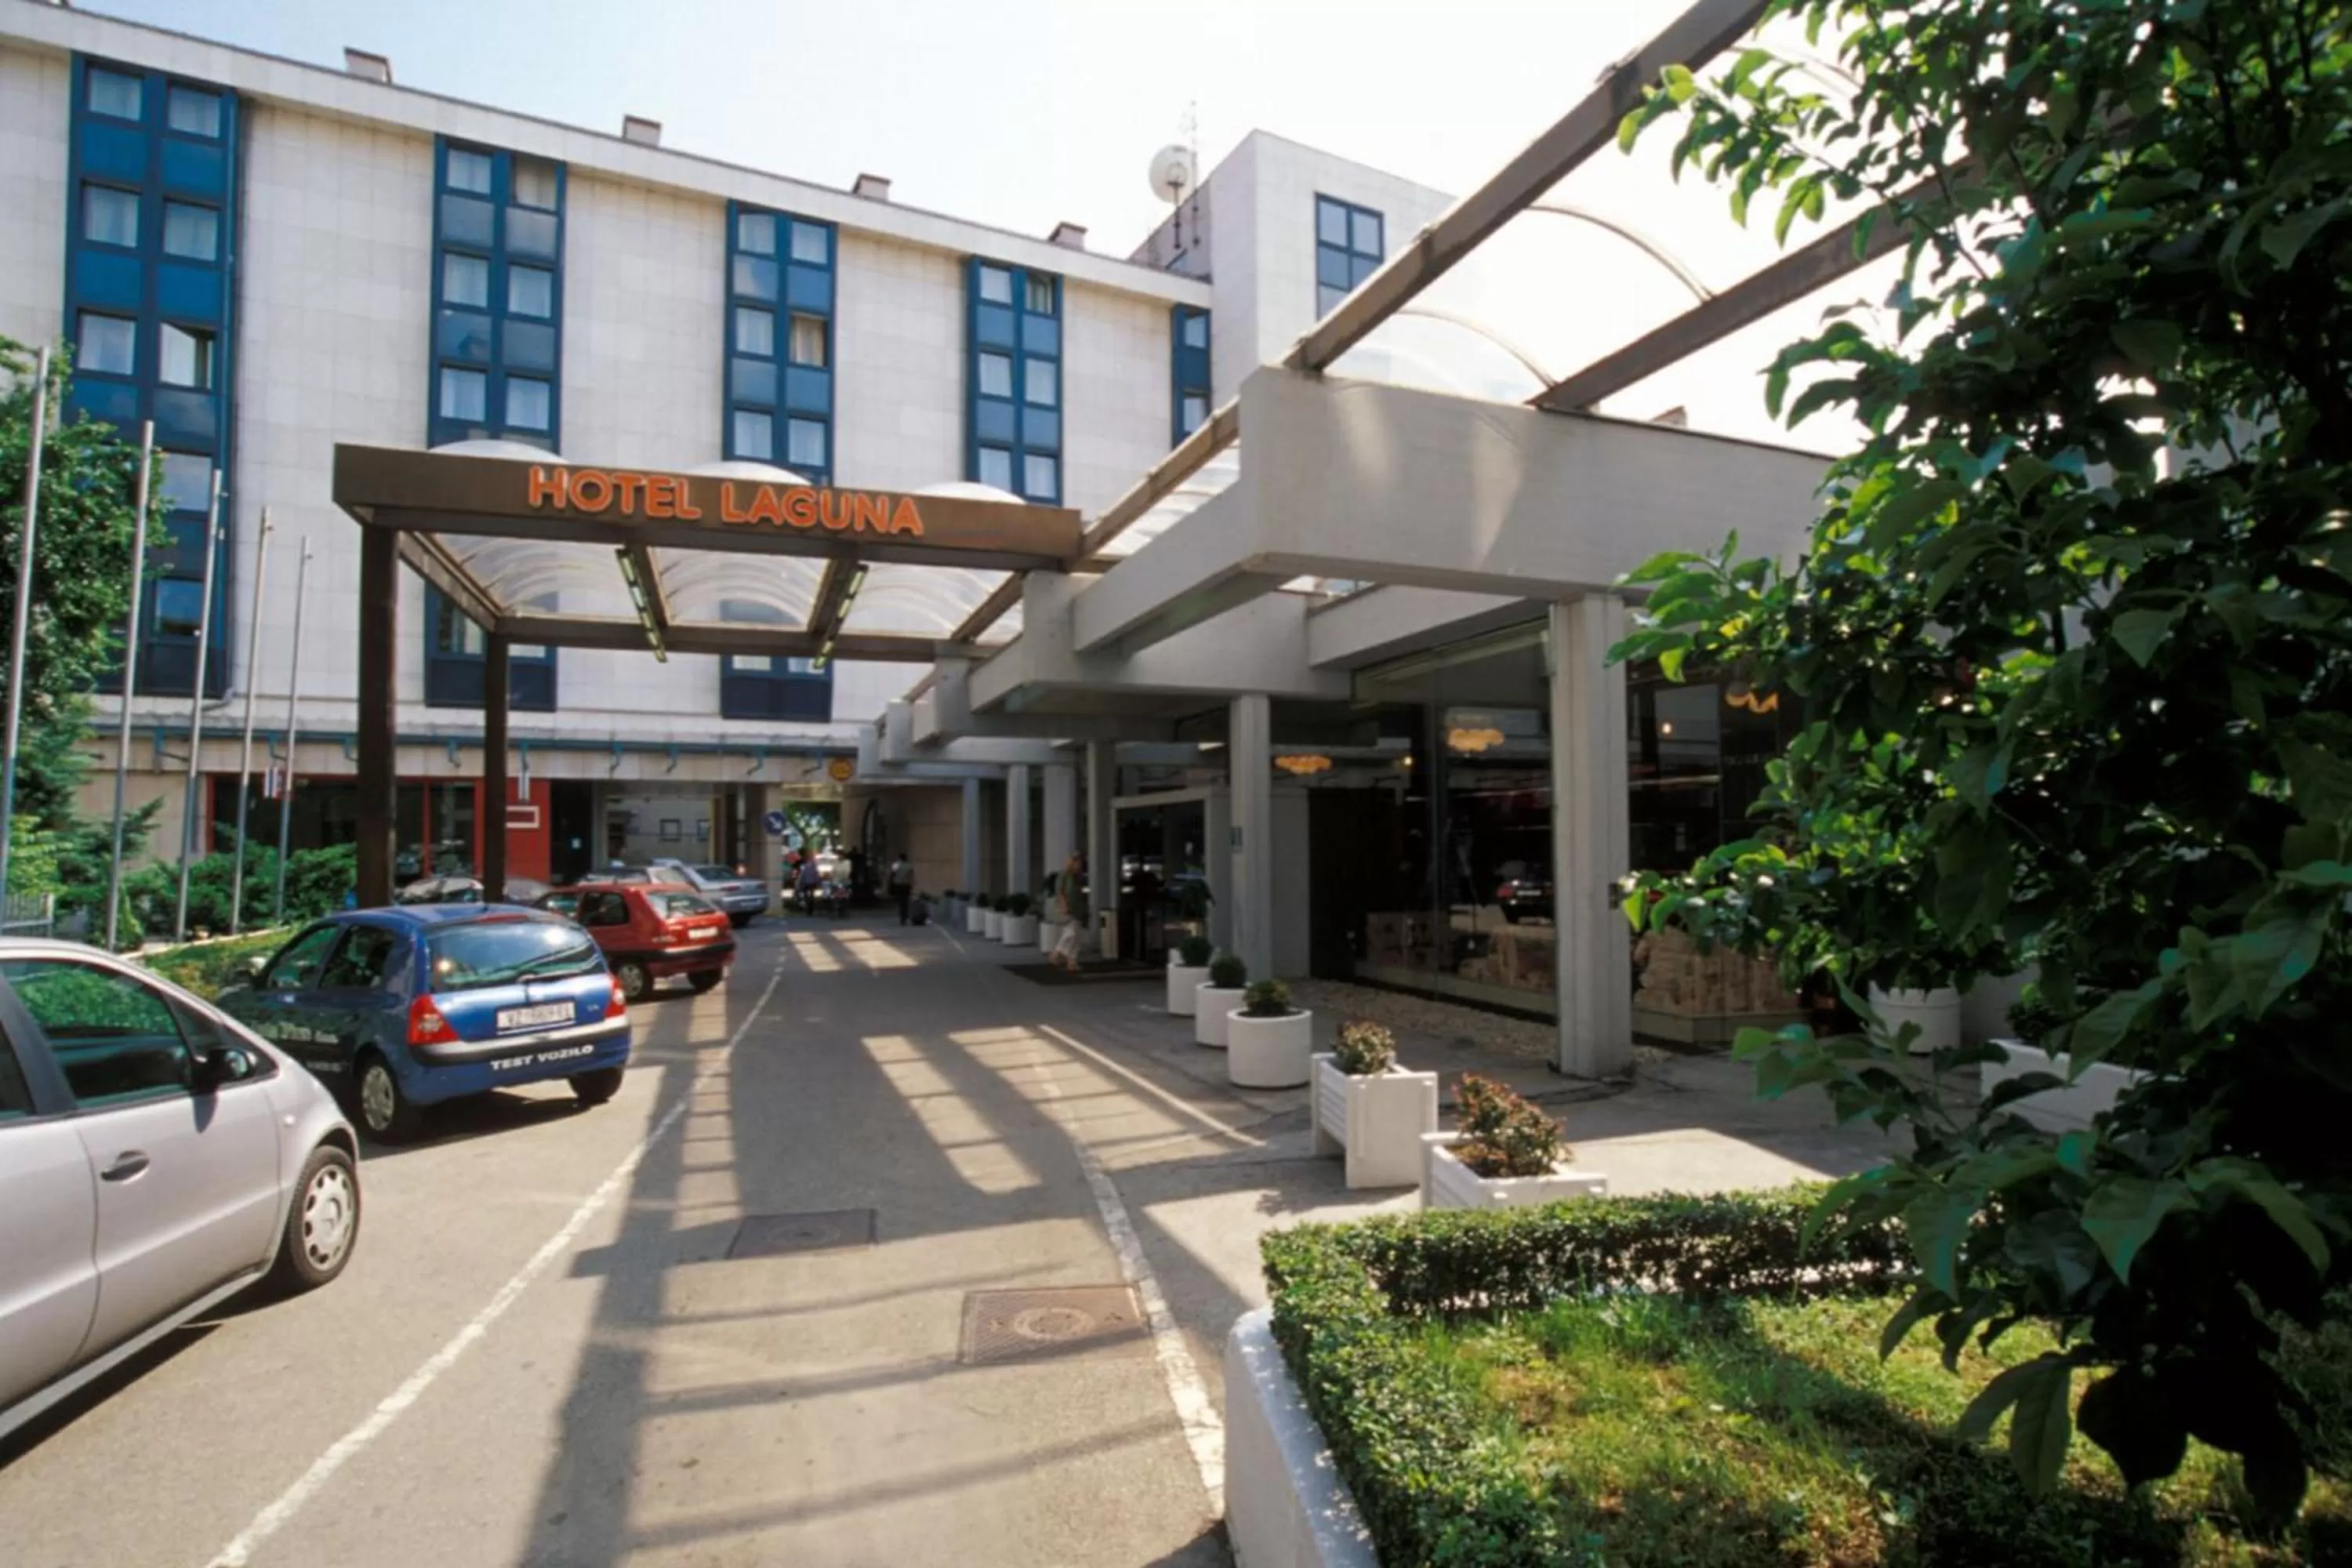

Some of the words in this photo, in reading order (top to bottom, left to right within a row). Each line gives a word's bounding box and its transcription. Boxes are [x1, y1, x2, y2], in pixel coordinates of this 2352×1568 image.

[528, 466, 701, 519] HOTEL
[720, 481, 924, 535] LAGUNA
[490, 1054, 533, 1070] TEST
[537, 1044, 594, 1062] VOZILO
